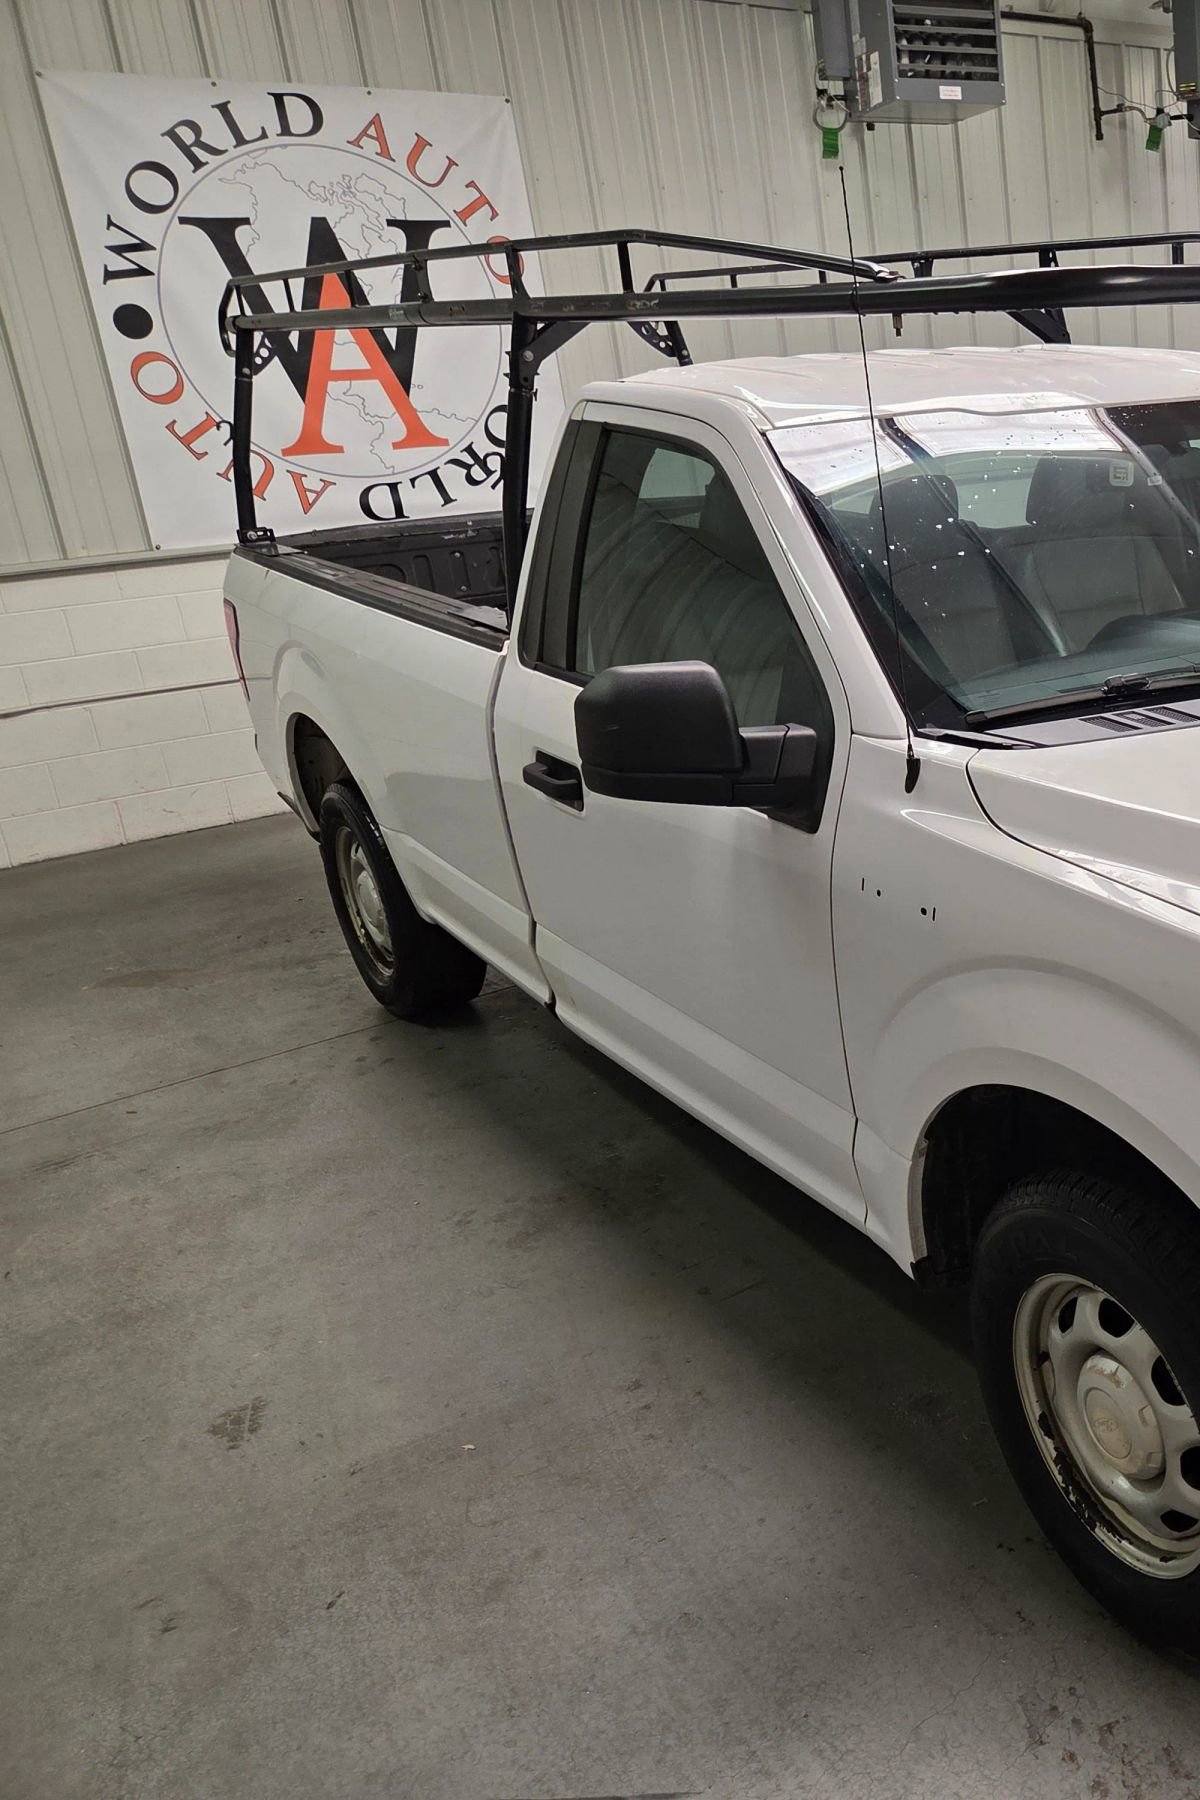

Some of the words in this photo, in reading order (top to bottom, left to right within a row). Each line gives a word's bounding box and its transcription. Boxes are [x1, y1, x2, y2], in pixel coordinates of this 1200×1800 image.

[102, 91, 325, 286] WORLD
[346, 112, 526, 285] AUTO
[130, 350, 337, 515] AUTO
